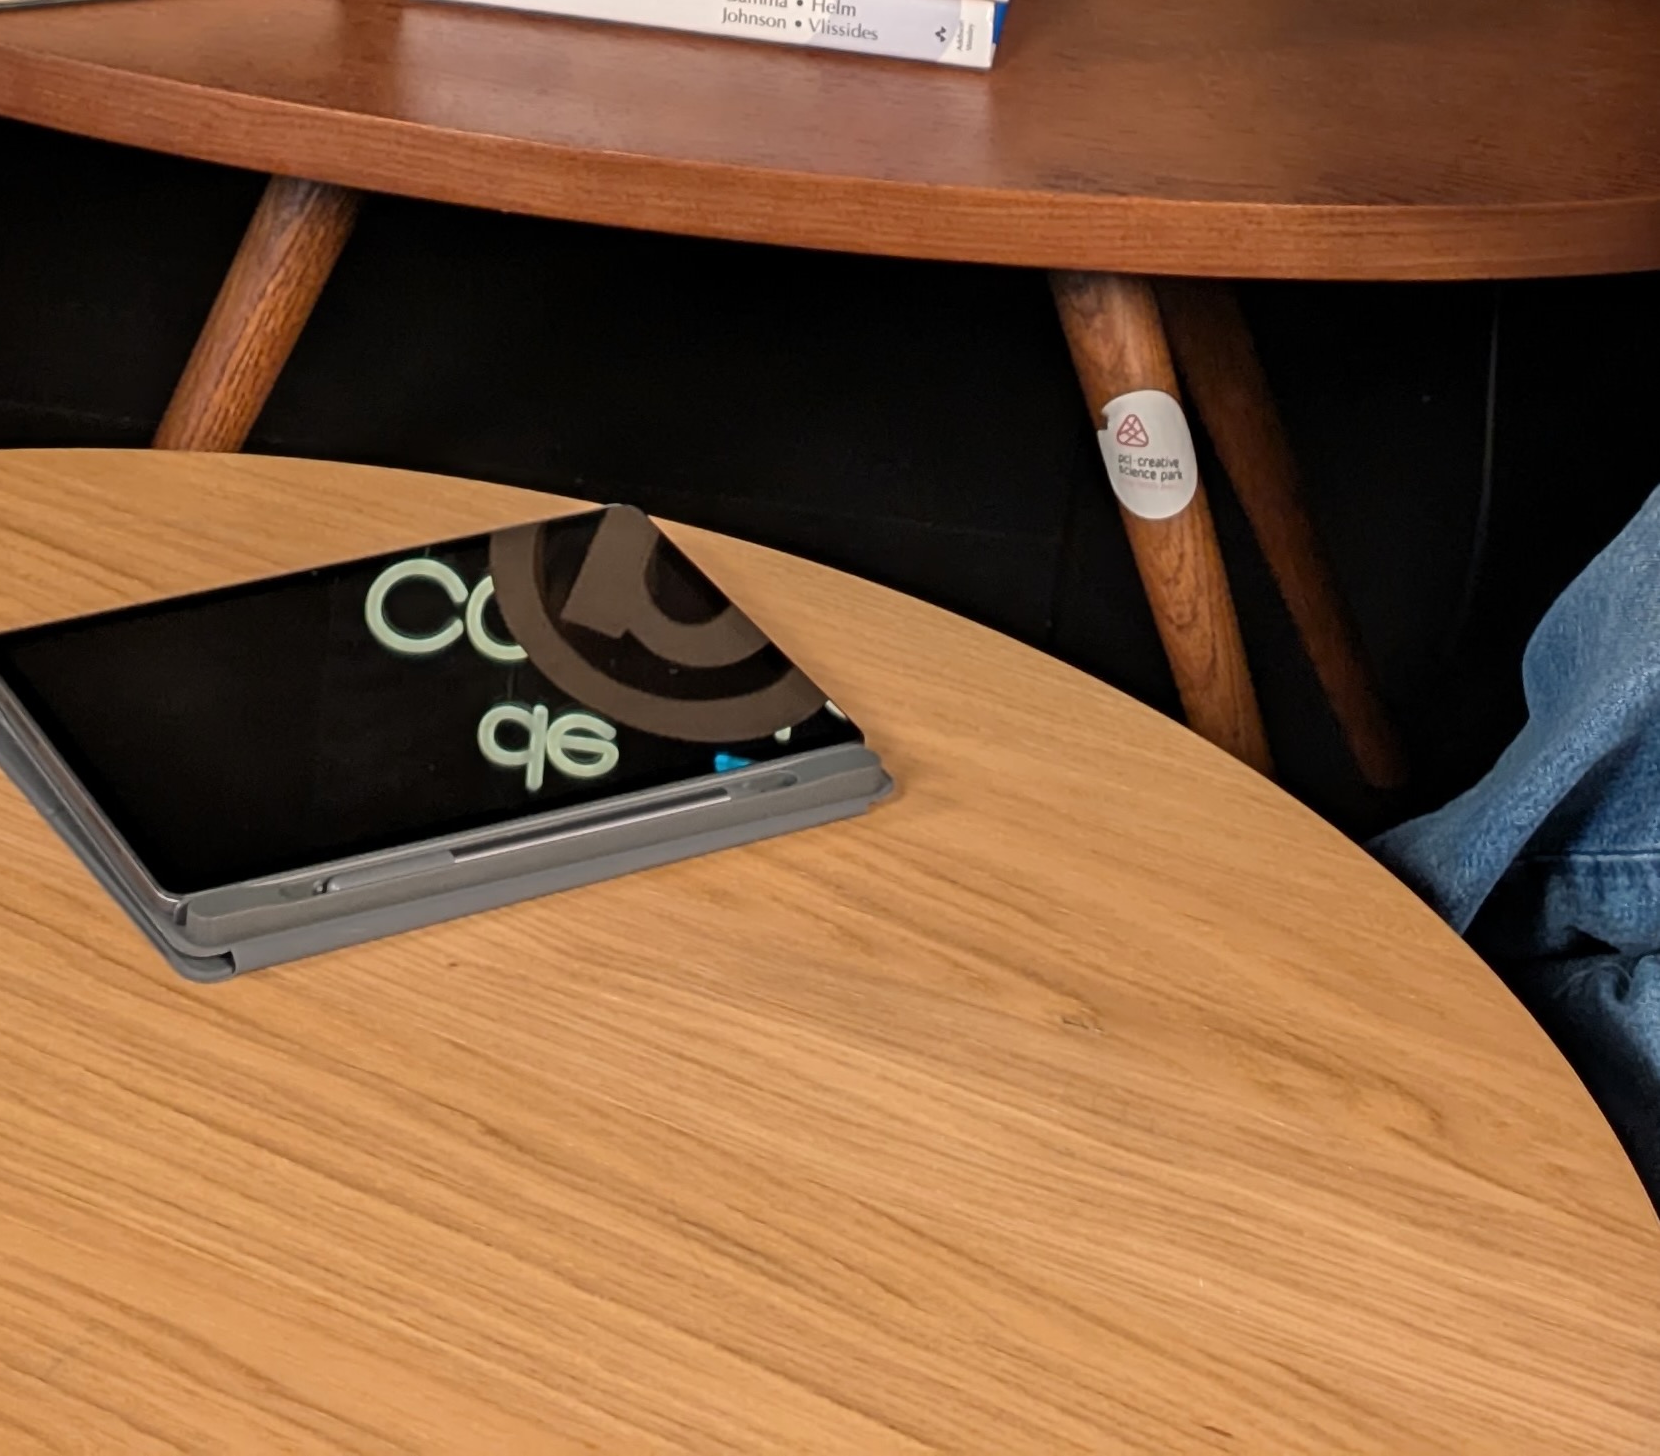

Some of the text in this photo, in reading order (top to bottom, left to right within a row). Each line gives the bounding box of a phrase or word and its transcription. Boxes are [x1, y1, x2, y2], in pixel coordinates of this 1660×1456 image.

[721, 7, 879, 41] Johnson Vlissides
[1137, 456, 1180, 469] creative
[1119, 465, 1183, 483] science park
